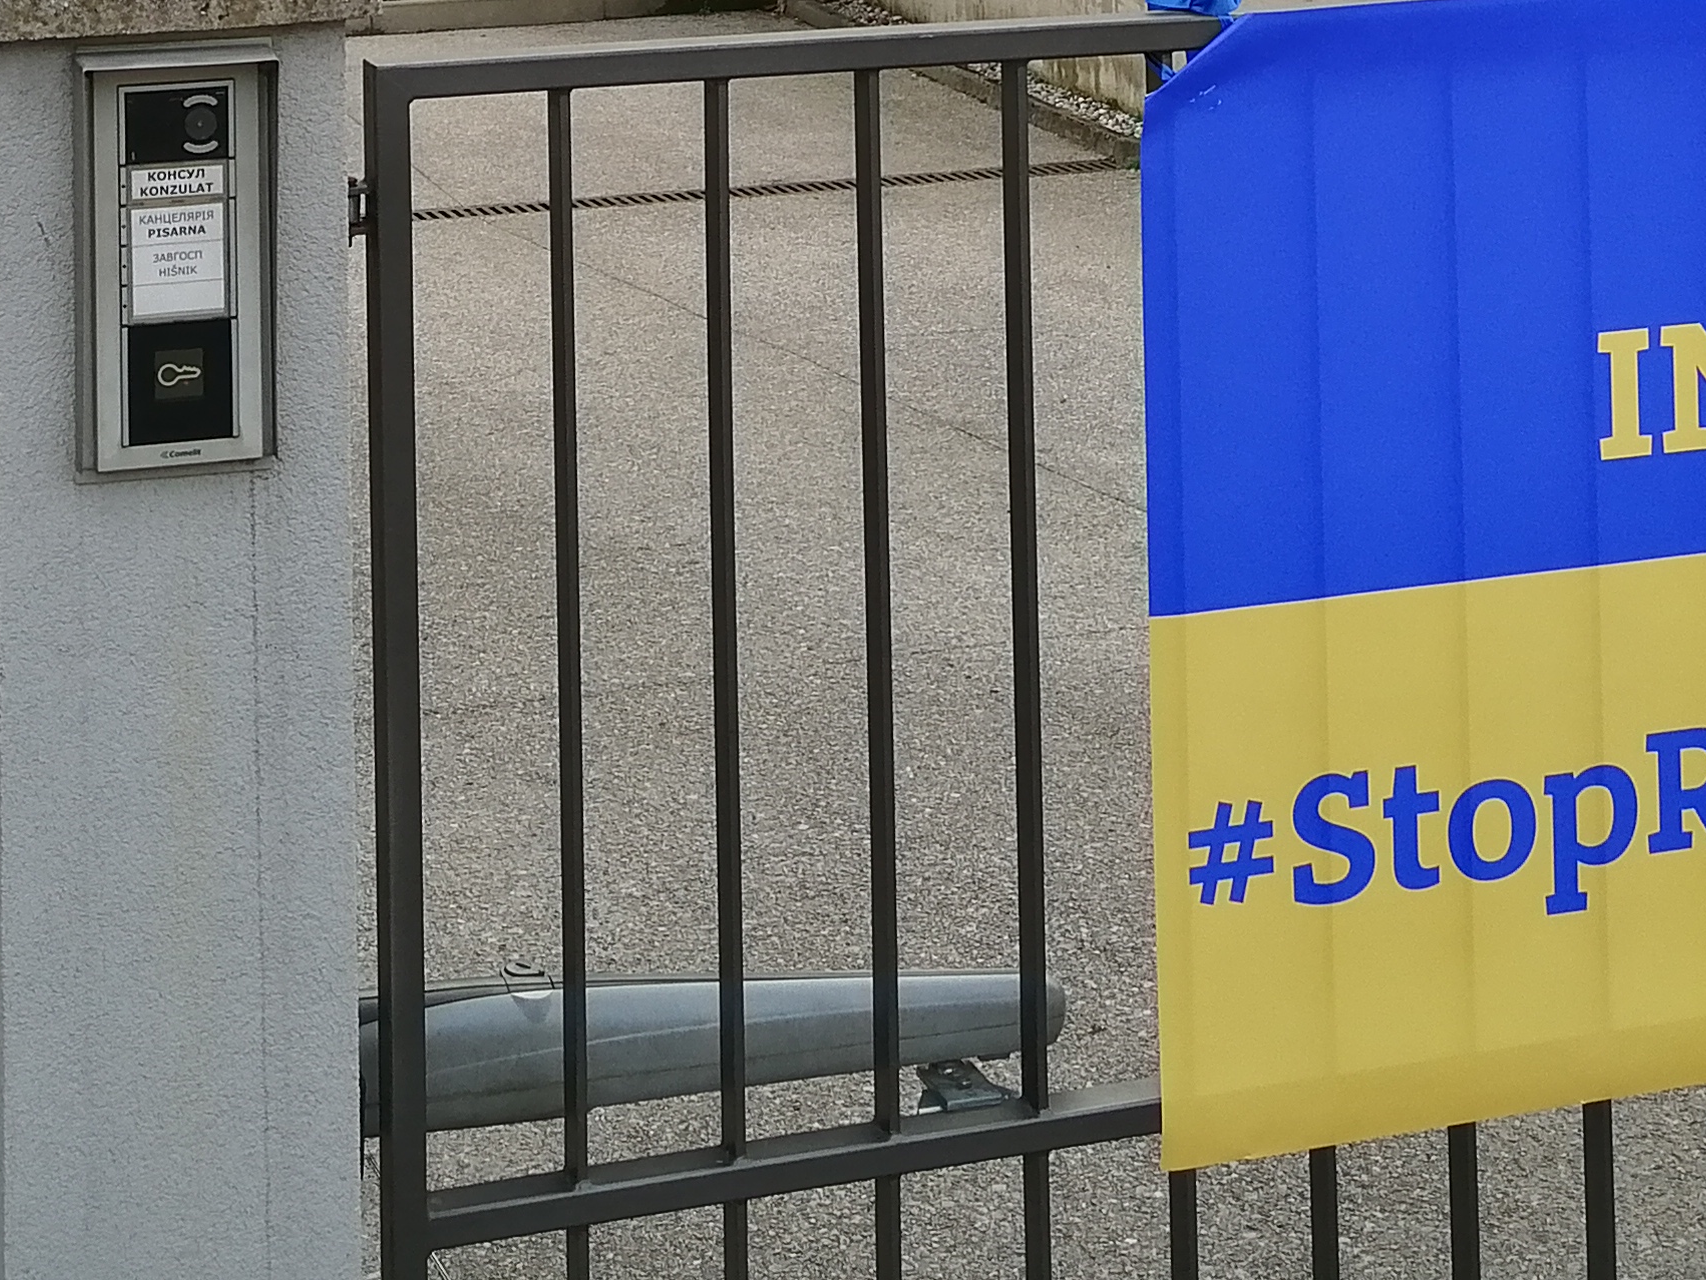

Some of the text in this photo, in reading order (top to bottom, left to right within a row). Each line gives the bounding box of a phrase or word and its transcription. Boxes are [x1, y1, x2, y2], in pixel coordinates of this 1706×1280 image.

[147, 167, 205, 182] КОНСУЛ
[140, 182, 214, 197] KONZULAT
[138, 209, 214, 226] КАНЦЕЛЯРІЯ
[147, 225, 206, 238] PISARNA
[152, 250, 203, 264] ЗАВГОСП
[159, 264, 198, 278] HIŠNIK
